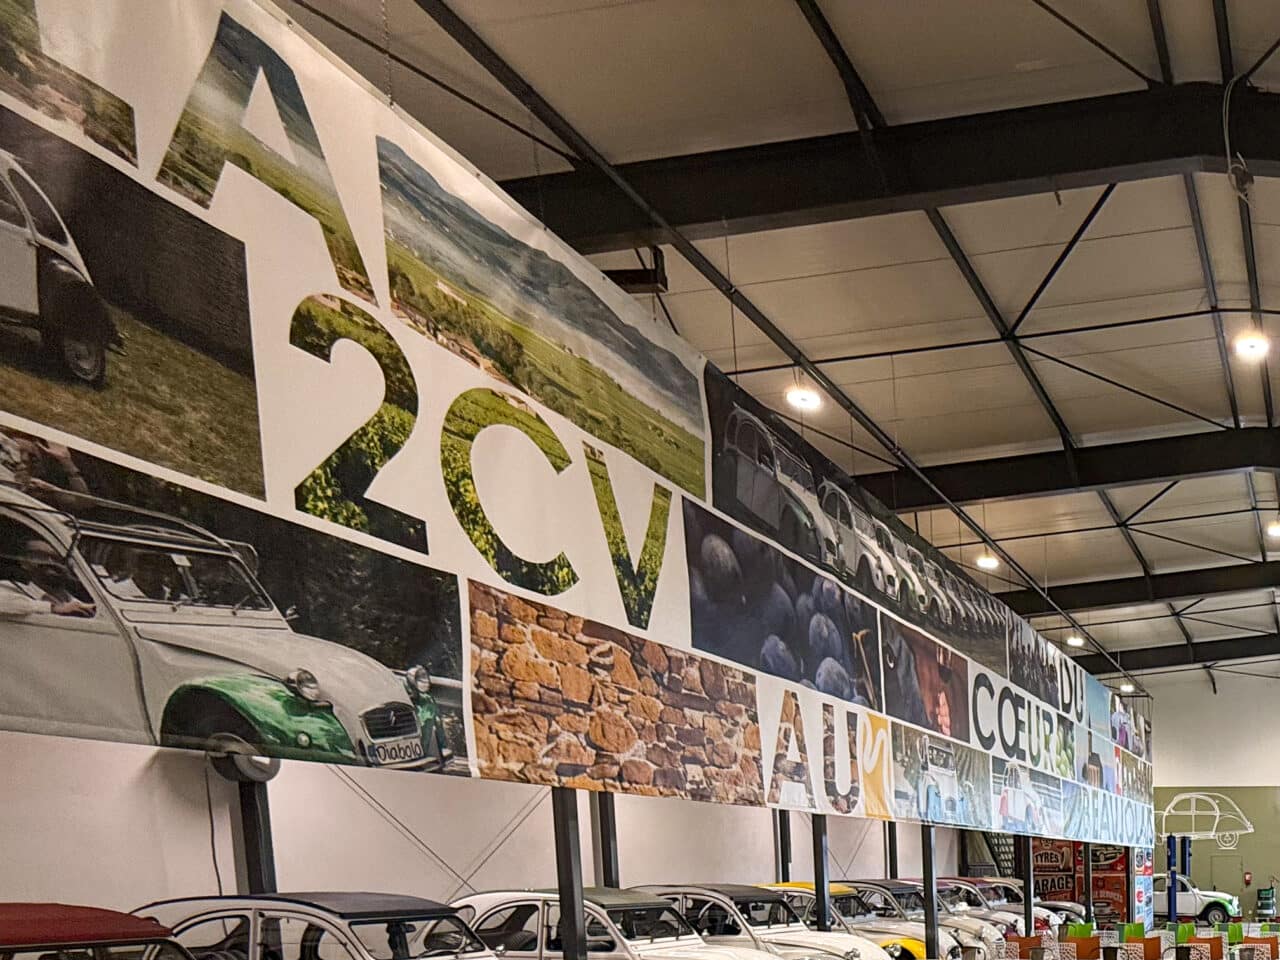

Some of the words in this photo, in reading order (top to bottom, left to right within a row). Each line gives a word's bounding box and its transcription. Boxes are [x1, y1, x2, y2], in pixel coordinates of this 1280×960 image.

[289, 293, 673, 631] 2CV
[1059, 655, 1084, 723] DU
[375, 741, 422, 761] Diabolo
[767, 689, 861, 814] AU
[1035, 851, 1060, 863] TYRES
[1033, 876, 1073, 898] ARAGE
